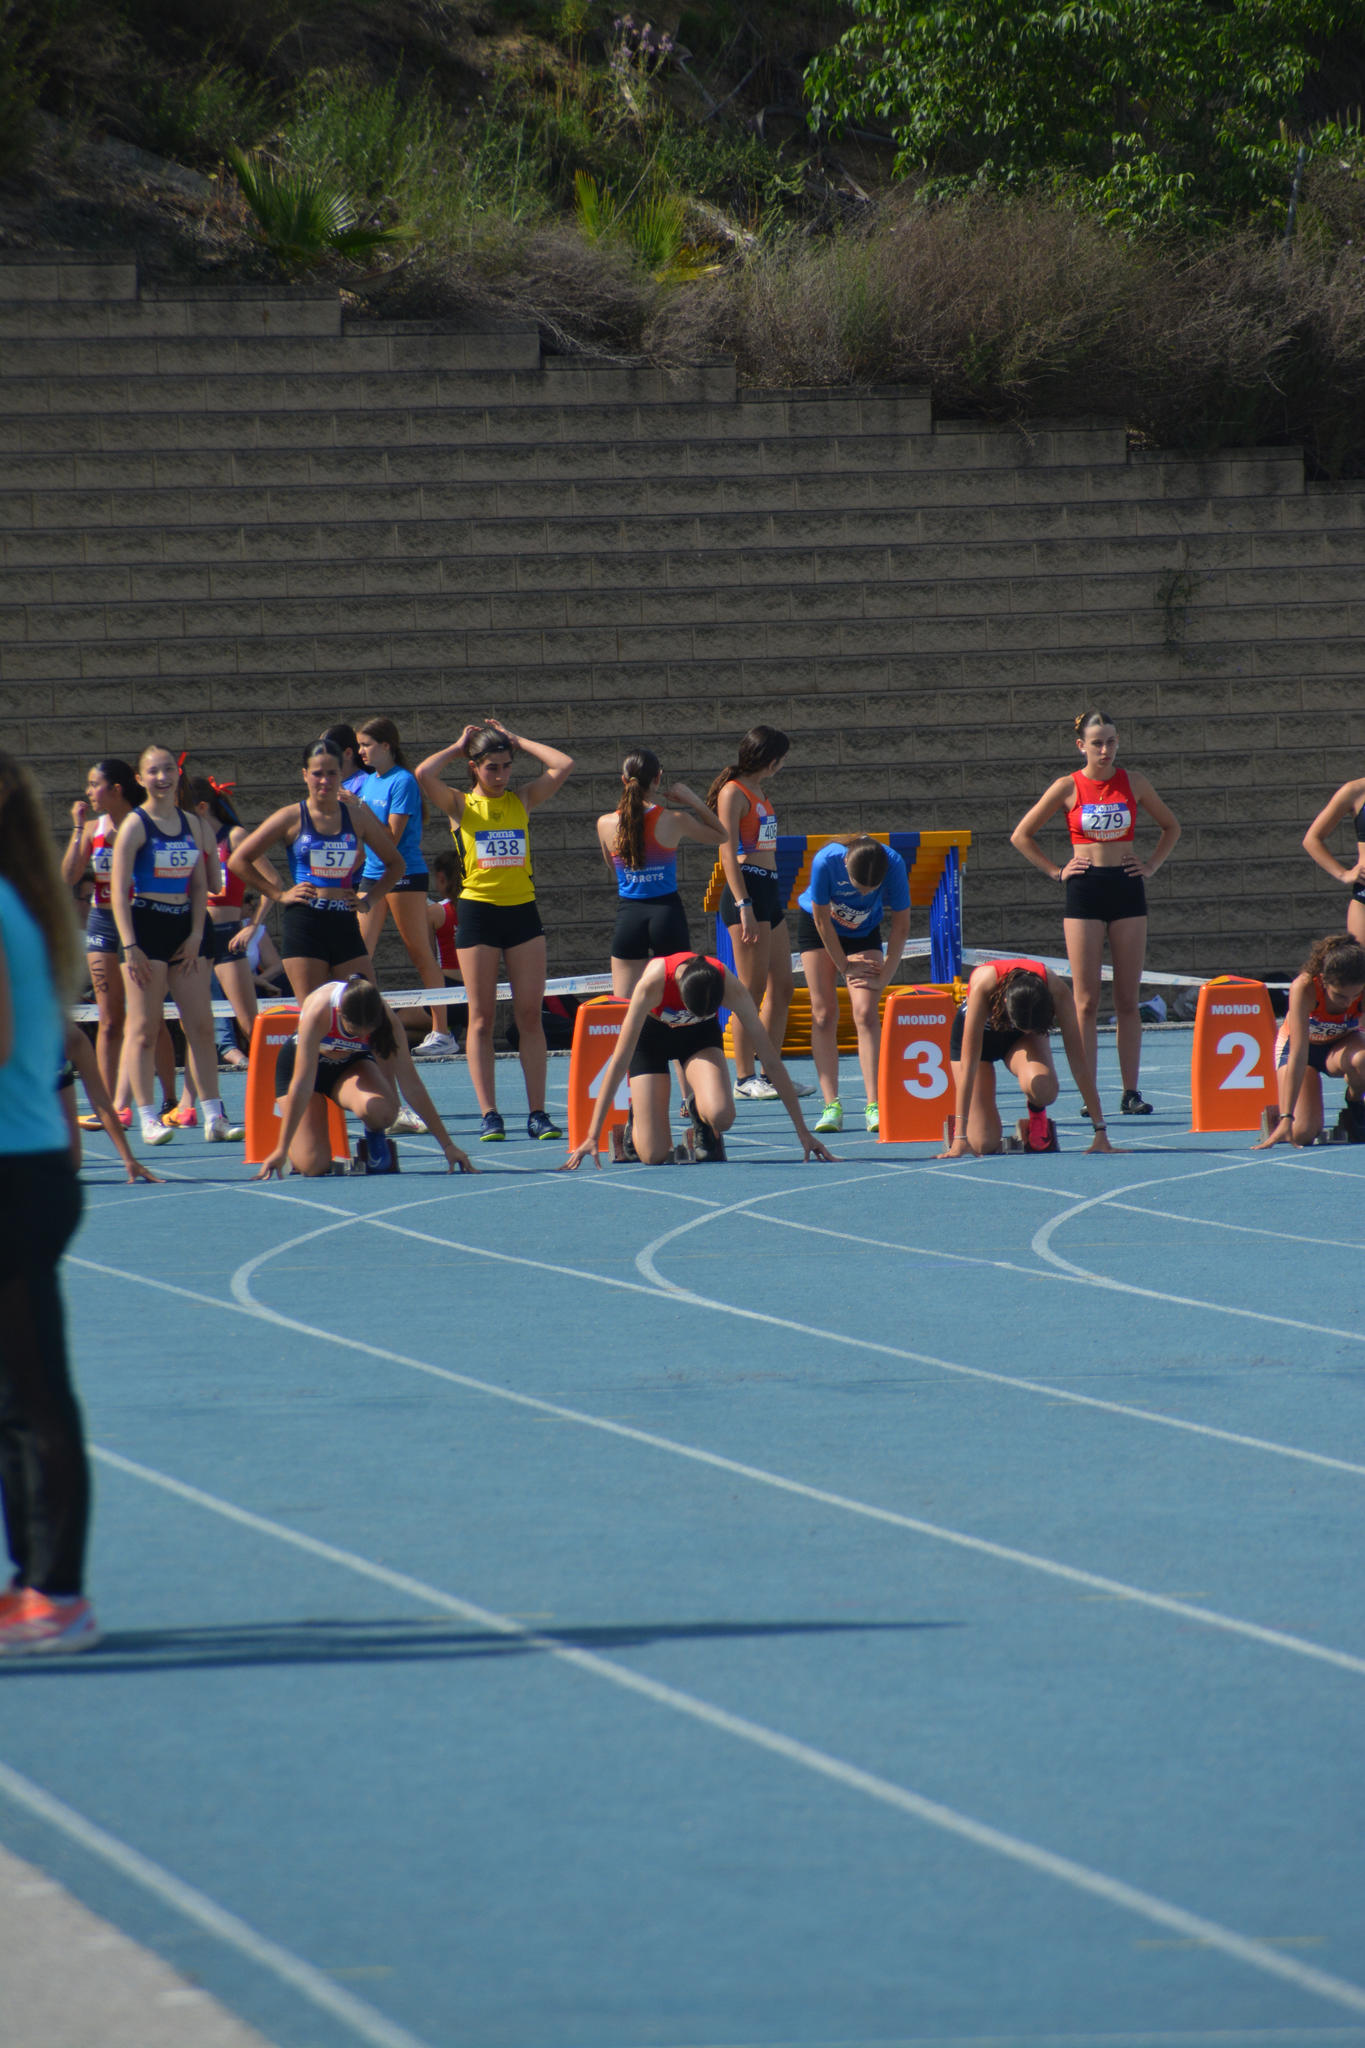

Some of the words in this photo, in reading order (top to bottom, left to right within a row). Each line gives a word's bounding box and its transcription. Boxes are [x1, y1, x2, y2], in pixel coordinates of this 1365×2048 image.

[1091, 813, 1124, 830] 279
[485, 840, 520, 856] 438
[170, 851, 188, 867] 65
[325, 851, 346, 867] 57
[1211, 1004, 1261, 1015] MONDO
[897, 1014, 947, 1025] MONDO
[588, 1024, 622, 1036] MON
[1216, 1031, 1266, 1091] 2
[903, 1040, 949, 1100] 3
